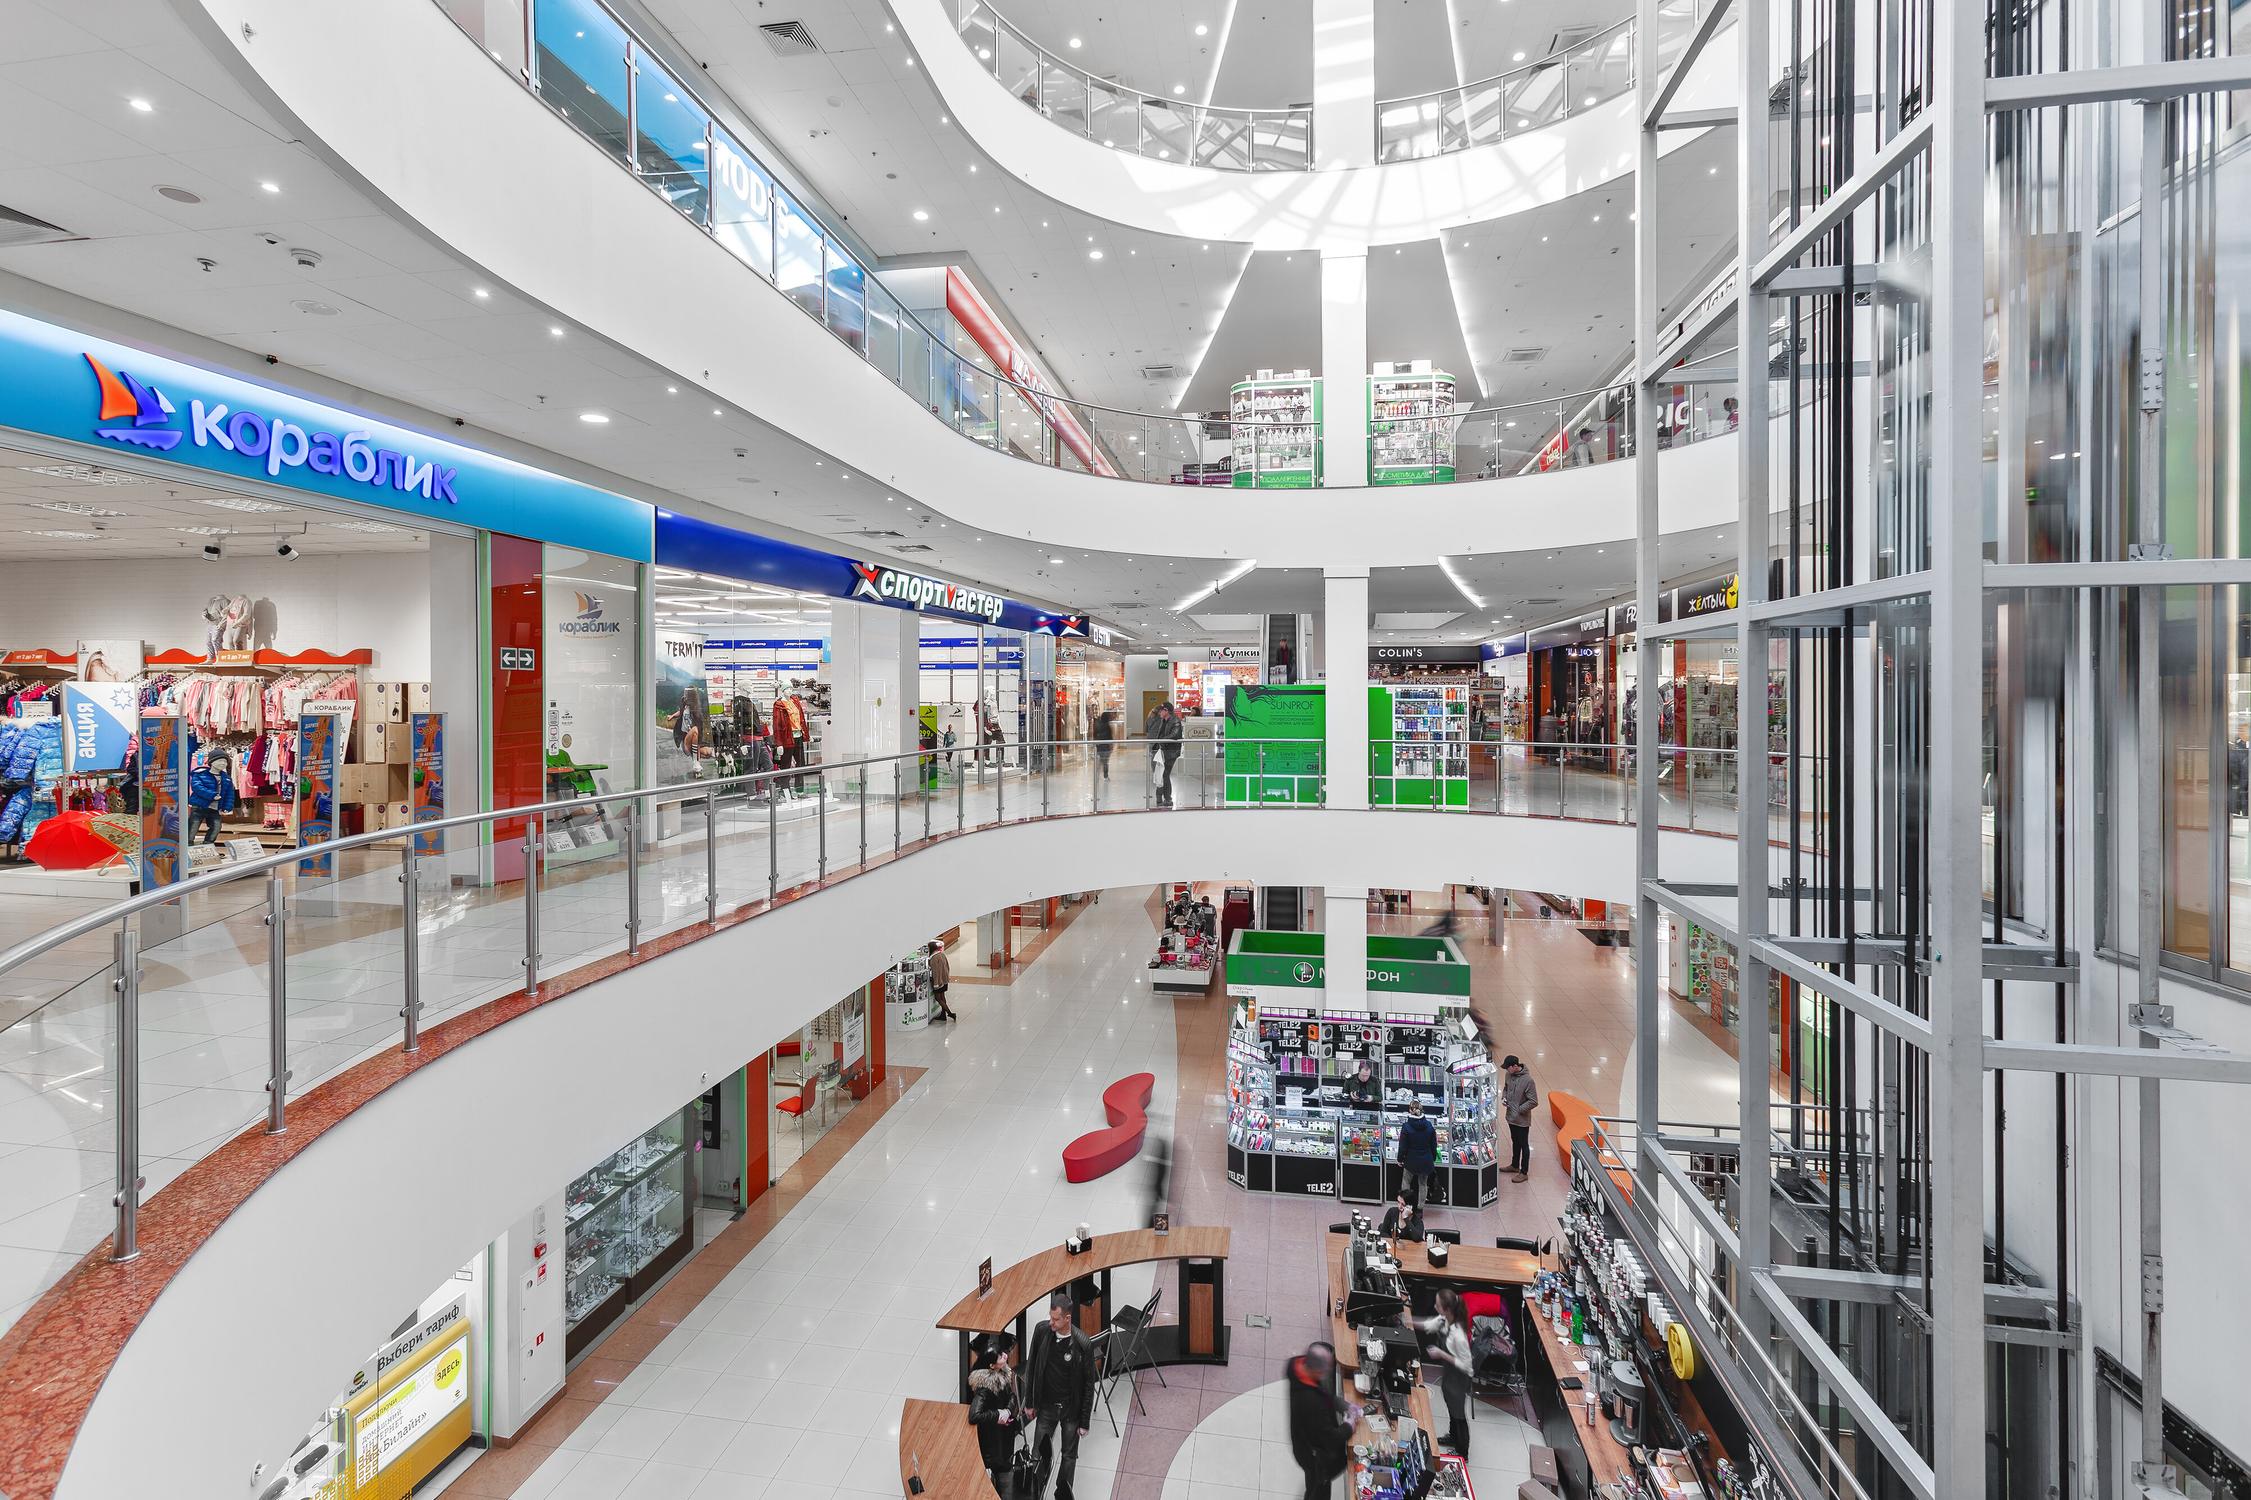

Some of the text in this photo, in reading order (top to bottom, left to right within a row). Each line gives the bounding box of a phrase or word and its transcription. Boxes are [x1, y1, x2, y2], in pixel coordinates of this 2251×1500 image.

[1688, 593, 1726, 613] ЖЁЛТЫЙ
[1378, 648, 1423, 657] COLIN'S
[1279, 1021, 1301, 1029] TELE2
[1339, 1024, 1362, 1032] TELE2
[1279, 1039, 1301, 1047] TELE2
[1339, 1042, 1362, 1051] TELE2
[1402, 1045, 1426, 1054] TELE2
[1228, 1170, 1245, 1186] TELE2
[1306, 1183, 1334, 1193] TELE2
[1481, 1187, 1498, 1204] TELE2
[377, 1304, 460, 1372] Выбери тариф
[437, 1359, 460, 1381] ЗДЕСЬ
